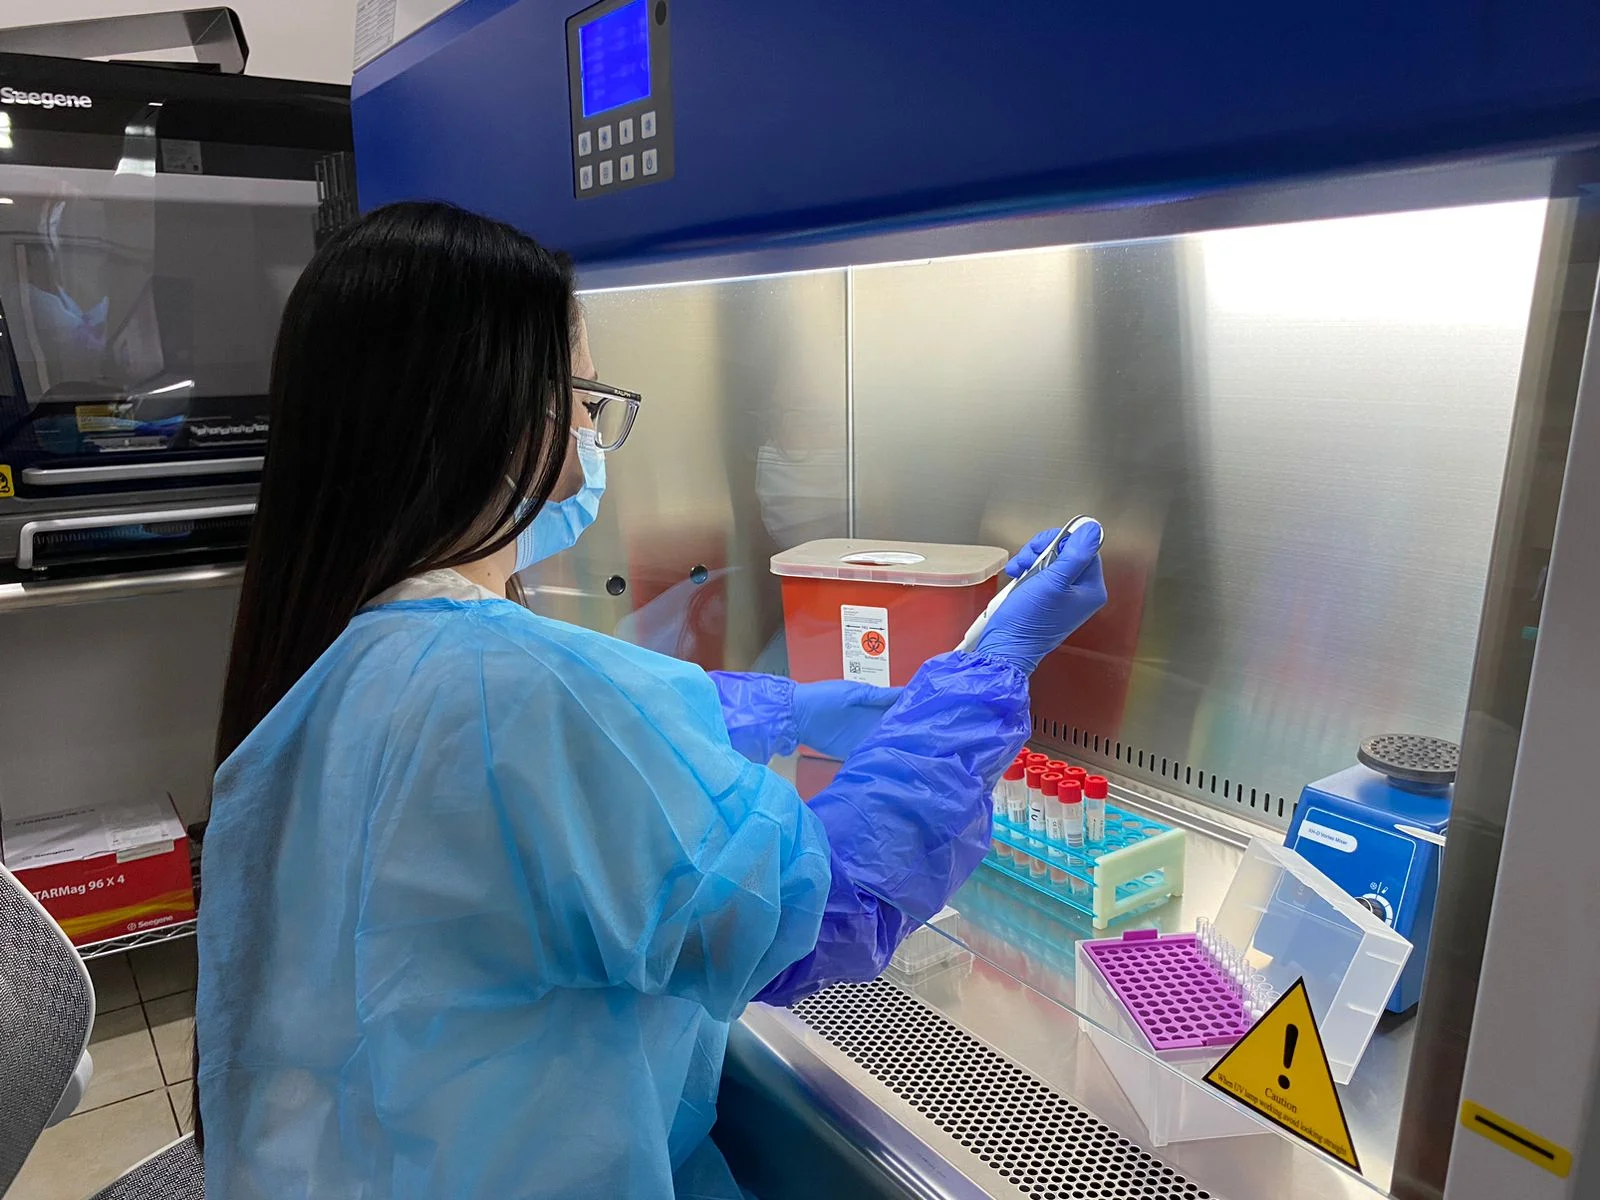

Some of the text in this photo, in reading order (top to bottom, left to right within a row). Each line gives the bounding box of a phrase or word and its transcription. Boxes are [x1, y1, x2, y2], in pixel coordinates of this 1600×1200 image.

[0, 87, 93, 109] Seegene
[33, 874, 126, 902] TARMag 96 X 4
[138, 915, 174, 928] Seegene
[1217, 1072, 1233, 1089] When
[1233, 1083, 1246, 1096] UV
[1245, 1088, 1259, 1105] lamp
[1259, 1098, 1283, 1120] working
[1283, 1114, 1300, 1129] avoid
[1300, 1121, 1323, 1143] looking
[1264, 1087, 1298, 1114] Caution
